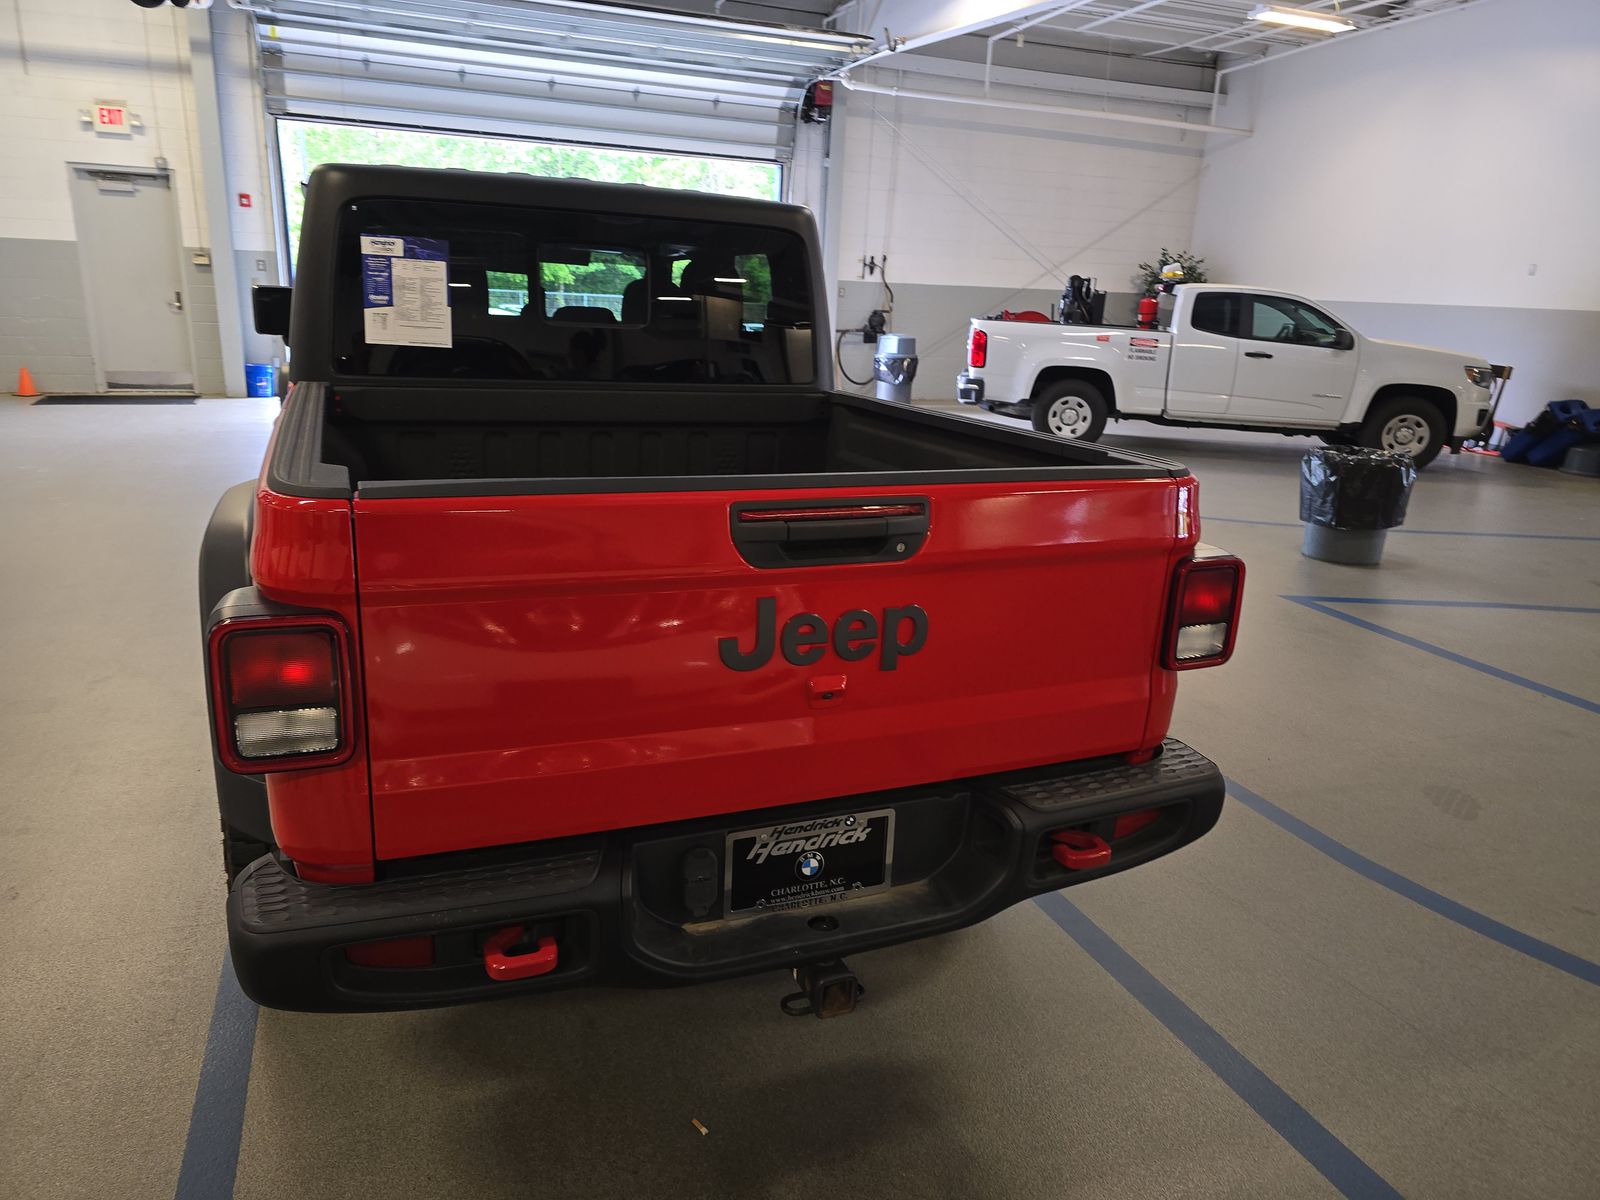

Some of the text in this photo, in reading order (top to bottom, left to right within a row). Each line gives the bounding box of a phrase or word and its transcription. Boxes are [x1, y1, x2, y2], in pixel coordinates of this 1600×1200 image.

[100, 107, 123, 125] EXIT
[718, 597, 928, 672] Jeep
[771, 817, 844, 838] Hendrick
[746, 827, 871, 864] Hendrick
[771, 878, 846, 896] CHARLOTTE, N.C.
